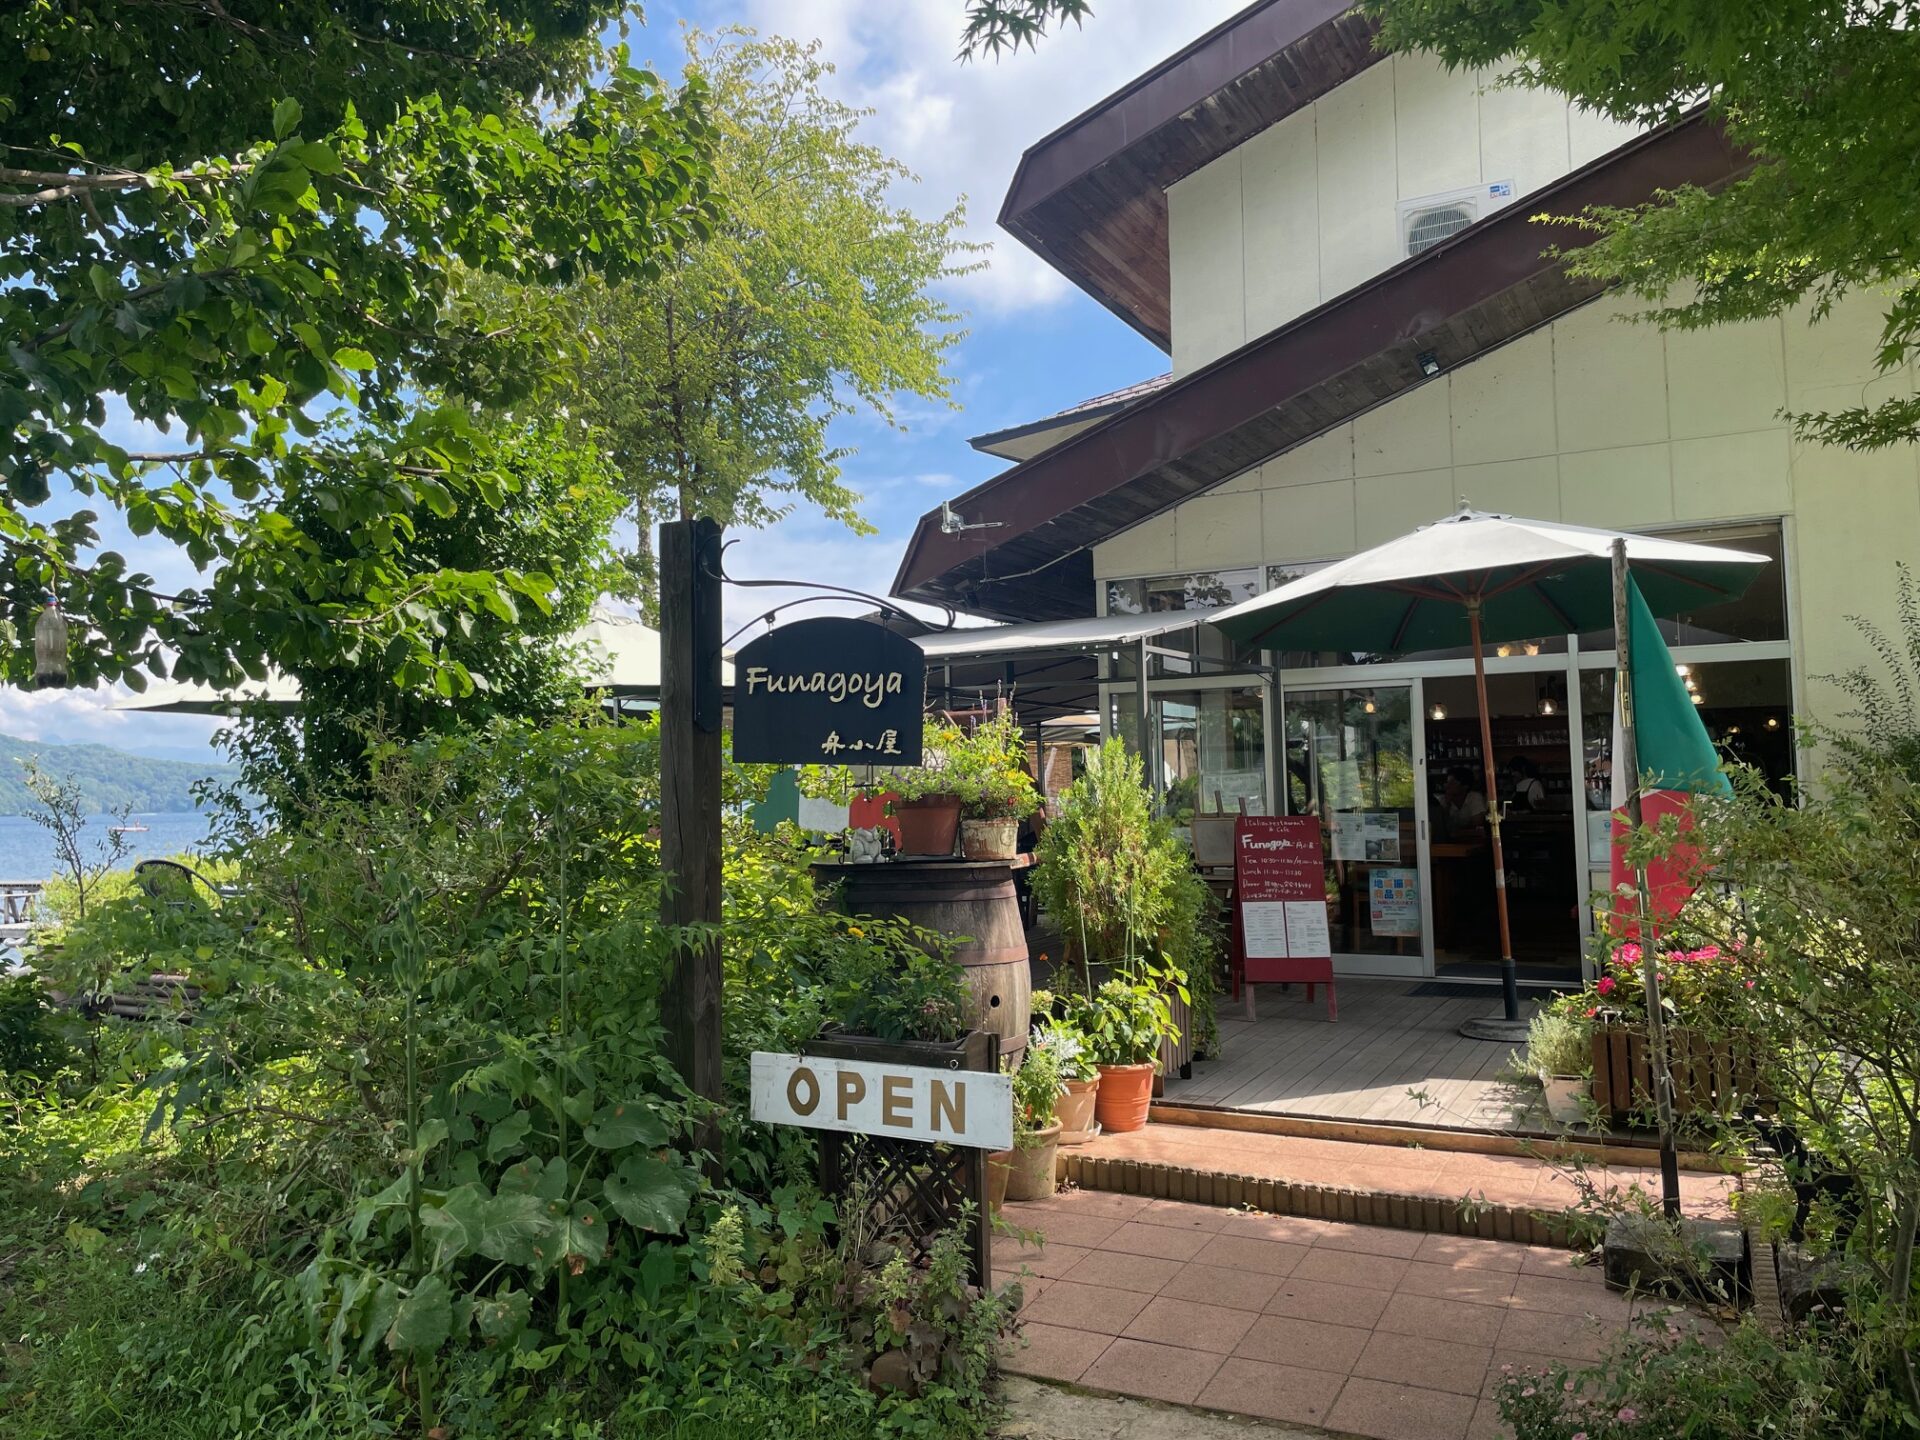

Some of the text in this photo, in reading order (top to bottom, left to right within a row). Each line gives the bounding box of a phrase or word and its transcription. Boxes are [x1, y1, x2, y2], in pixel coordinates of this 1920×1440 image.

[747, 667, 902, 709] Funagoya
[822, 729, 901, 756] 舟小屋
[1241, 833, 1293, 851] Funagoya
[787, 1066, 966, 1134] OPEN
